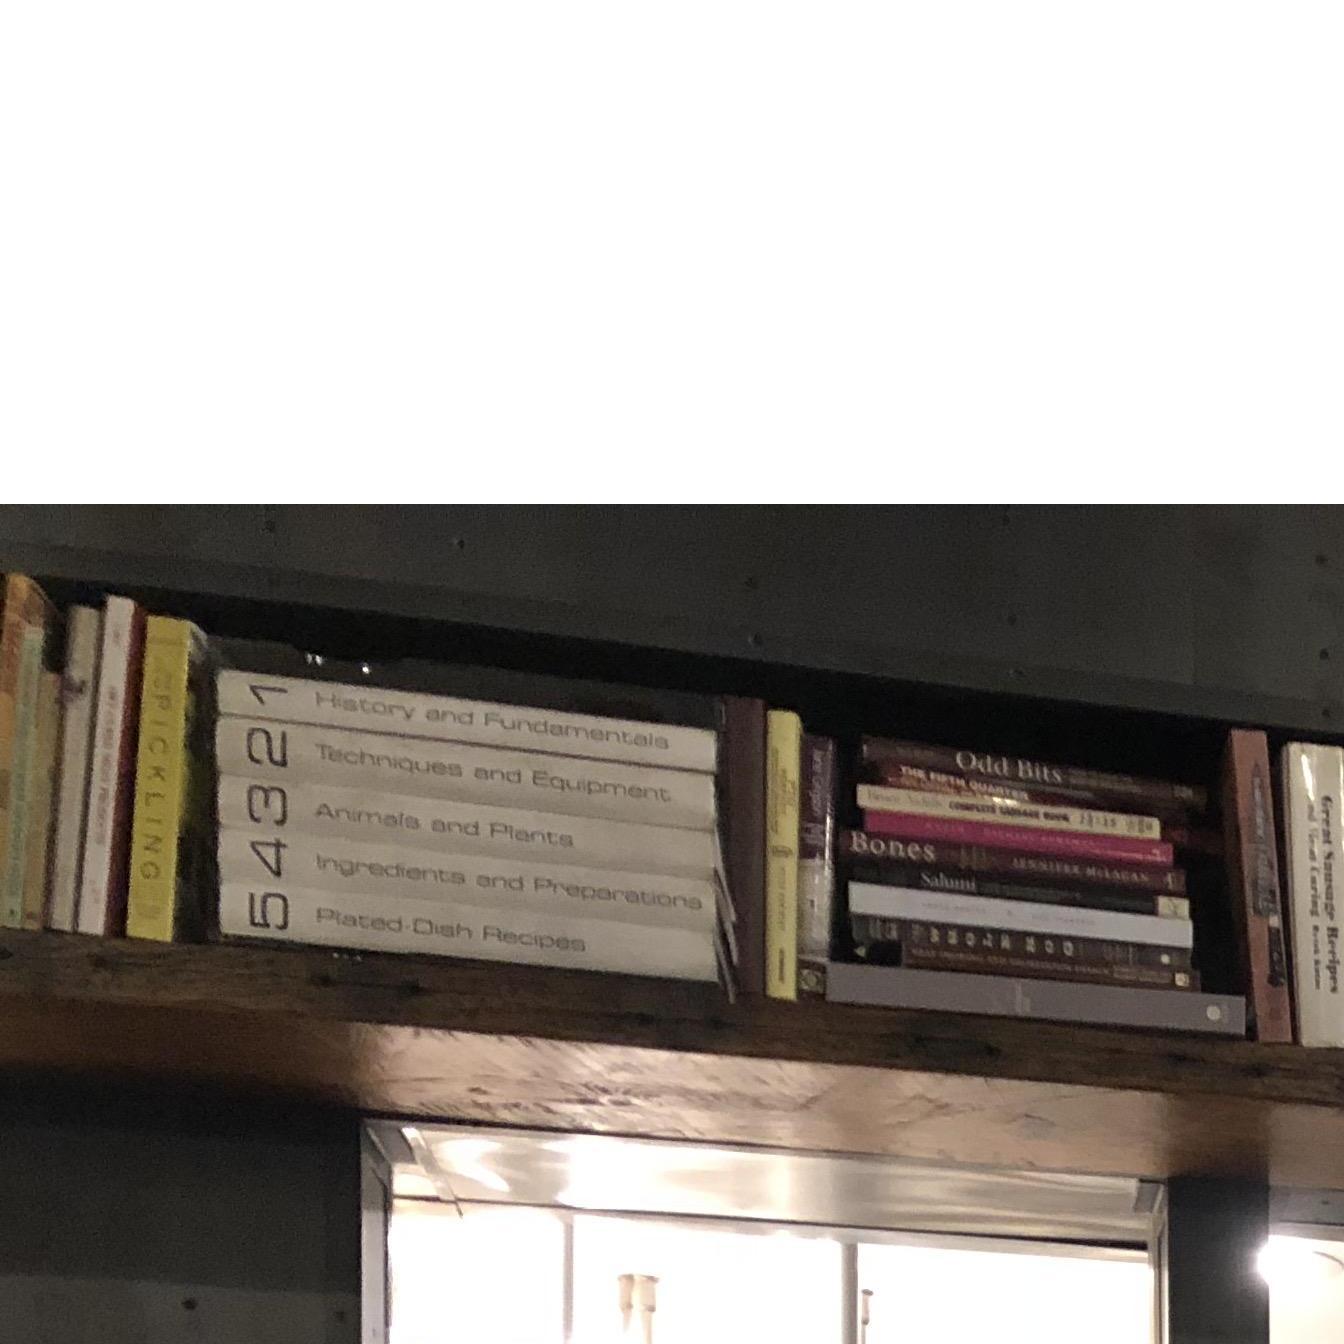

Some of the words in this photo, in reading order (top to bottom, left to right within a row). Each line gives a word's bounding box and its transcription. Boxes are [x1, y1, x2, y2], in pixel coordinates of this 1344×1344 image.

[250, 684, 288, 705] 1
[316, 692, 417, 721] History
[425, 707, 475, 726] and
[484, 712, 669, 750] Fundamentals
[247, 727, 288, 768] 2
[956, 750, 1009, 780] Odd
[1017, 757, 1064, 784] Bits
[139, 695, 167, 881] PICKLING
[315, 743, 464, 778] Techniques
[474, 766, 522, 785] and
[531, 770, 672, 803] Equipment
[248, 784, 288, 827] 3
[316, 803, 420, 831] Animals
[431, 817, 479, 837] and
[490, 822, 574, 848] Plants
[250, 838, 288, 878] 4
[848, 831, 936, 862] Bones
[316, 853, 466, 884] Ingredients
[476, 873, 524, 892] and
[533, 878, 703, 911] Preparations
[249, 892, 289, 930] 5
[482, 924, 586, 953] Recipes
